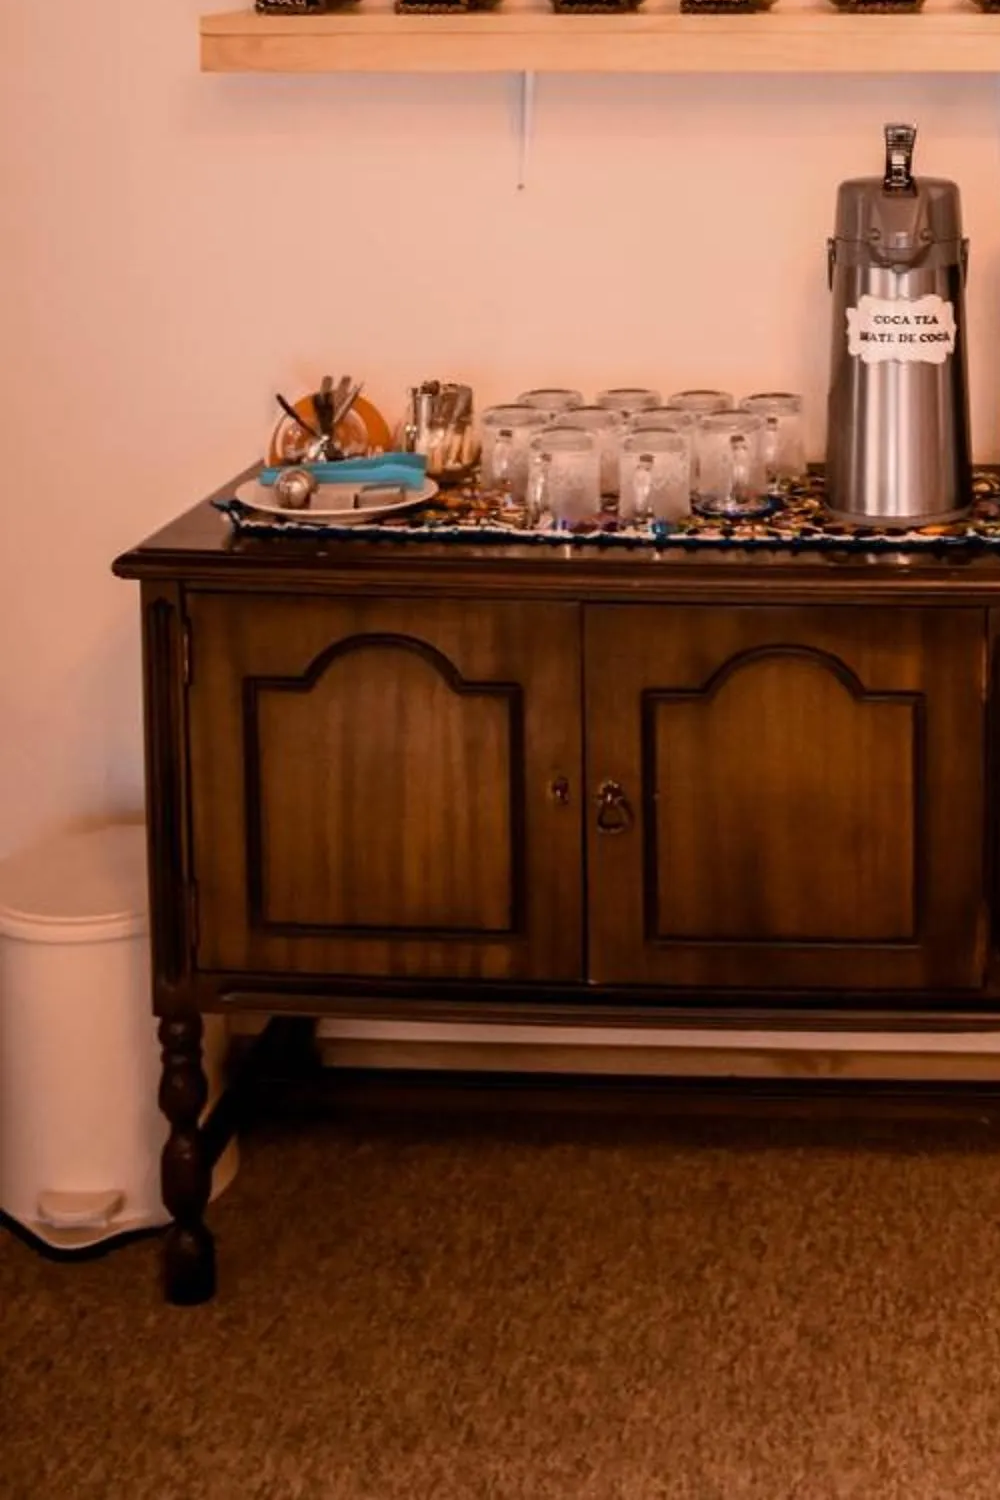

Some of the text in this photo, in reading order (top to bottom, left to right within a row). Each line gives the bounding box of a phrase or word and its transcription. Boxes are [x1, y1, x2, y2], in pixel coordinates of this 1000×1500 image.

[873, 314, 939, 325] COCA TEA
[898, 332, 916, 343] DE
[919, 331, 951, 343] COCA
